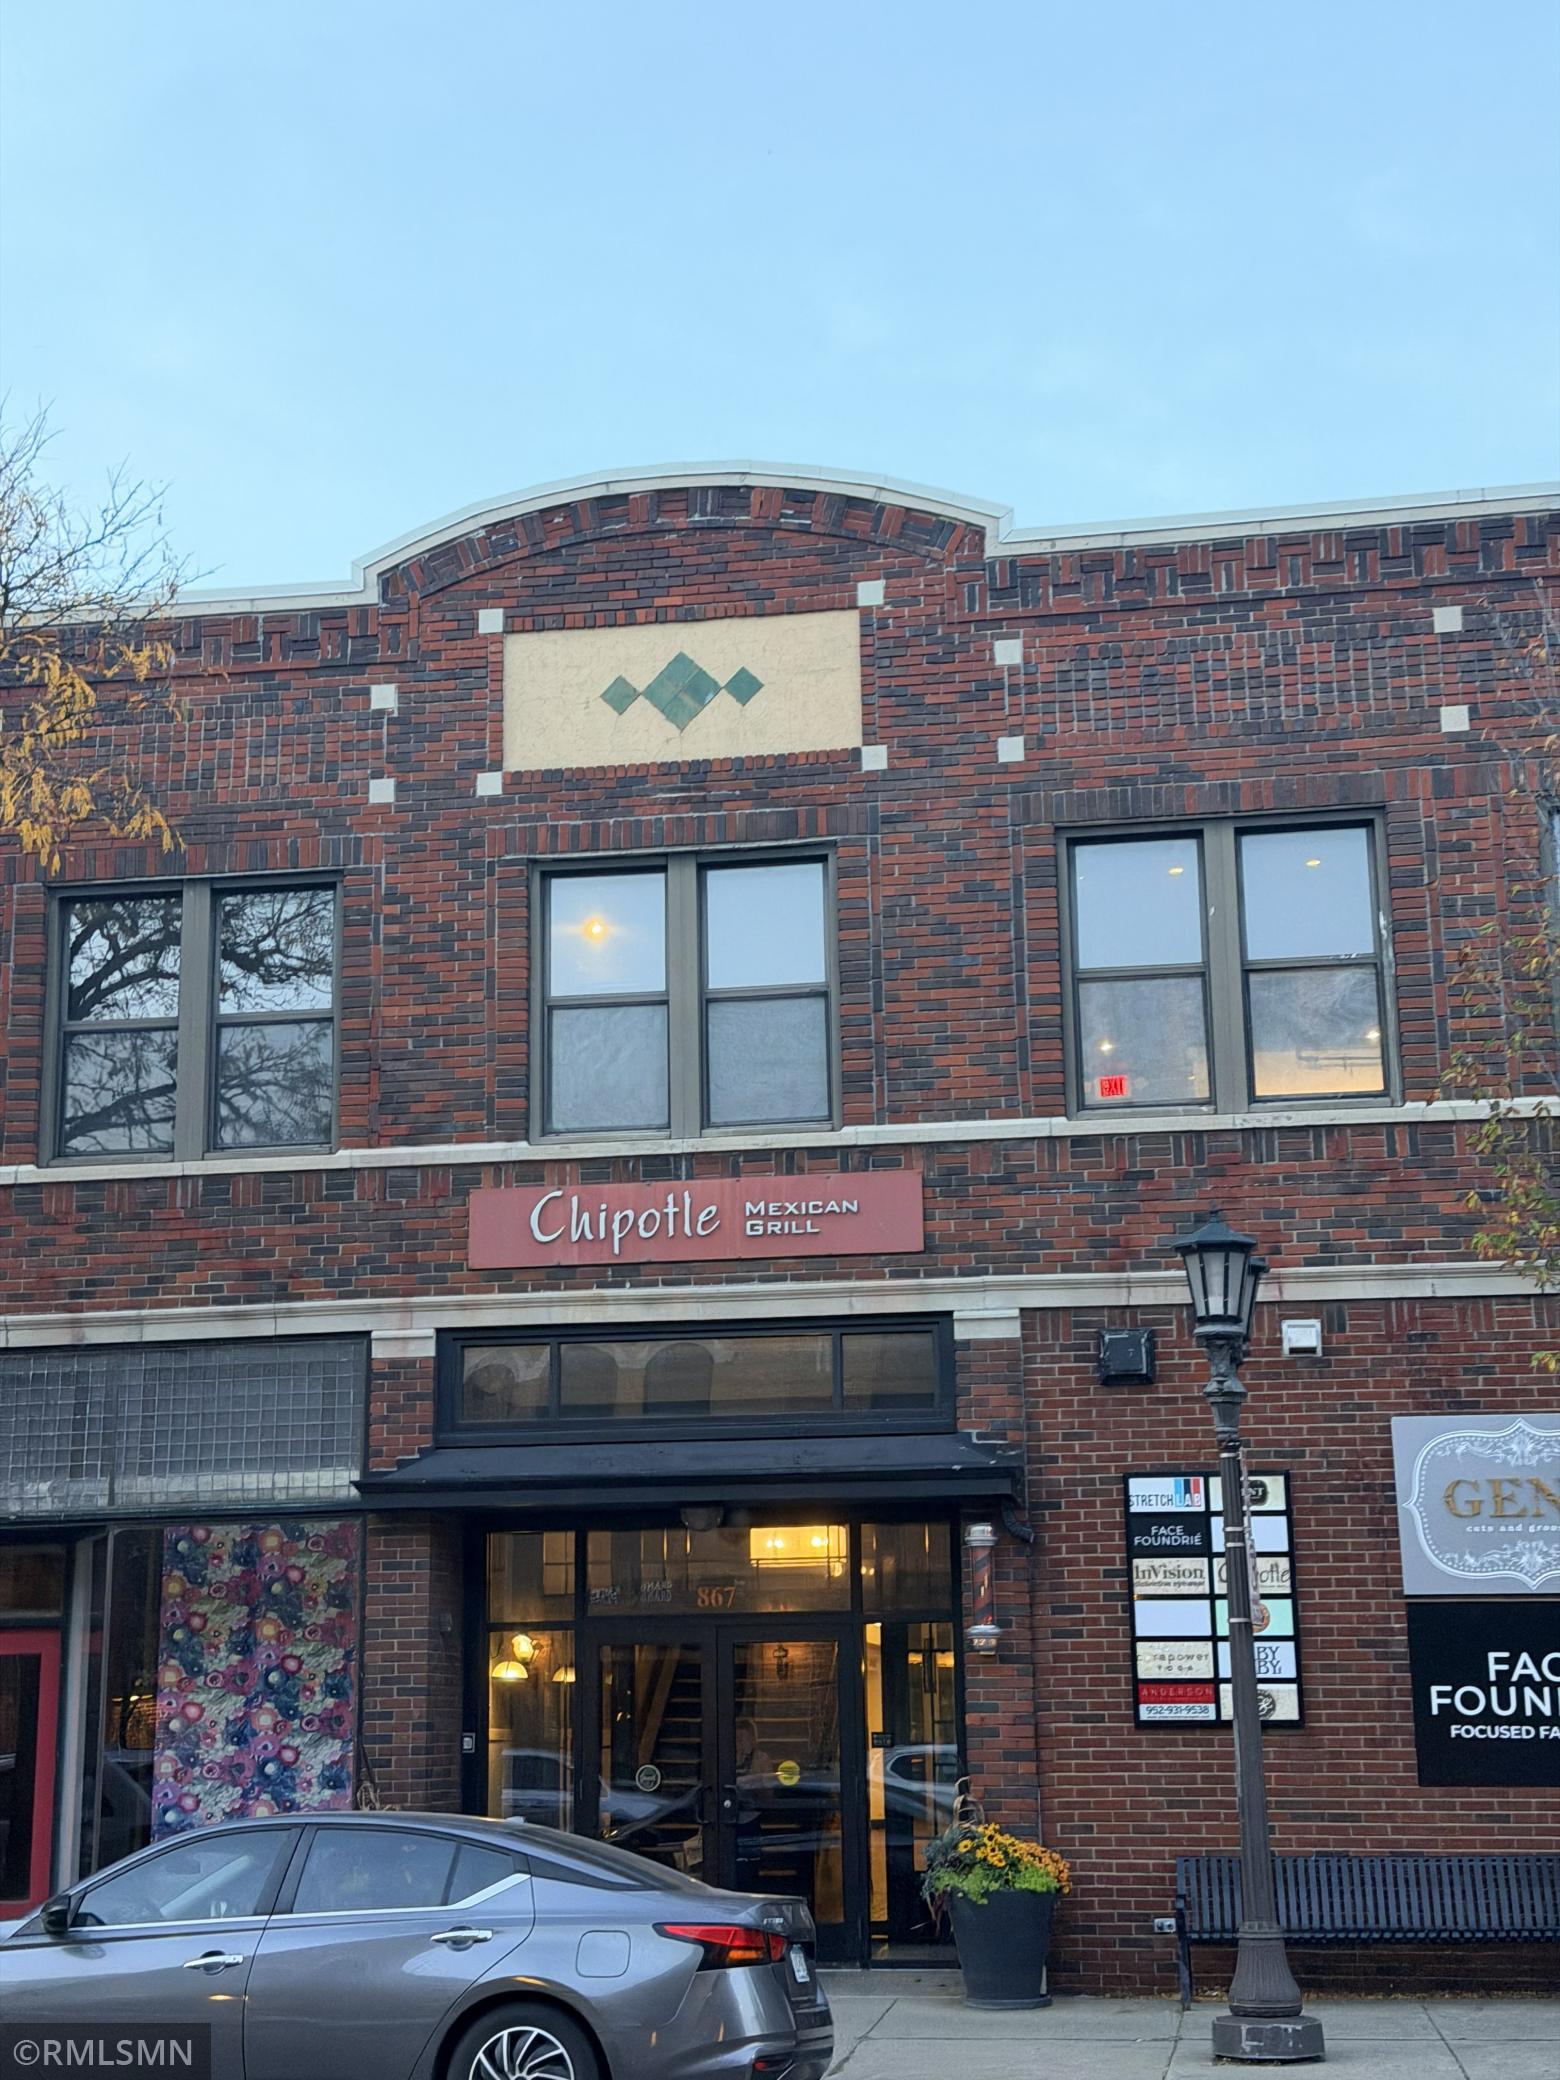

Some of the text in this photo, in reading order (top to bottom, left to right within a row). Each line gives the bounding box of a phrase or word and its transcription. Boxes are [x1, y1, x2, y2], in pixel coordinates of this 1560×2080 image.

[1100, 1078, 1125, 1096] EXIT
[745, 1199, 859, 1217] MEXICAN
[530, 1190, 721, 1255] Chipotle
[745, 1219, 821, 1236] GRILL
[1151, 1526, 1184, 1536] FACE
[1499, 1523, 1523, 1532] and
[1528, 1525, 1560, 1533] groo
[1134, 1532, 1202, 1546] FOUNDRIÉ
[1135, 1564, 1205, 1580] InVision
[697, 1587, 736, 1607] 867
[1487, 1651, 1560, 1682] FAC
[1142, 1687, 1213, 1697] ANDERSON
[1430, 1685, 1560, 1716] FOUN
[1450, 1724, 1535, 1739] FOCUSED
